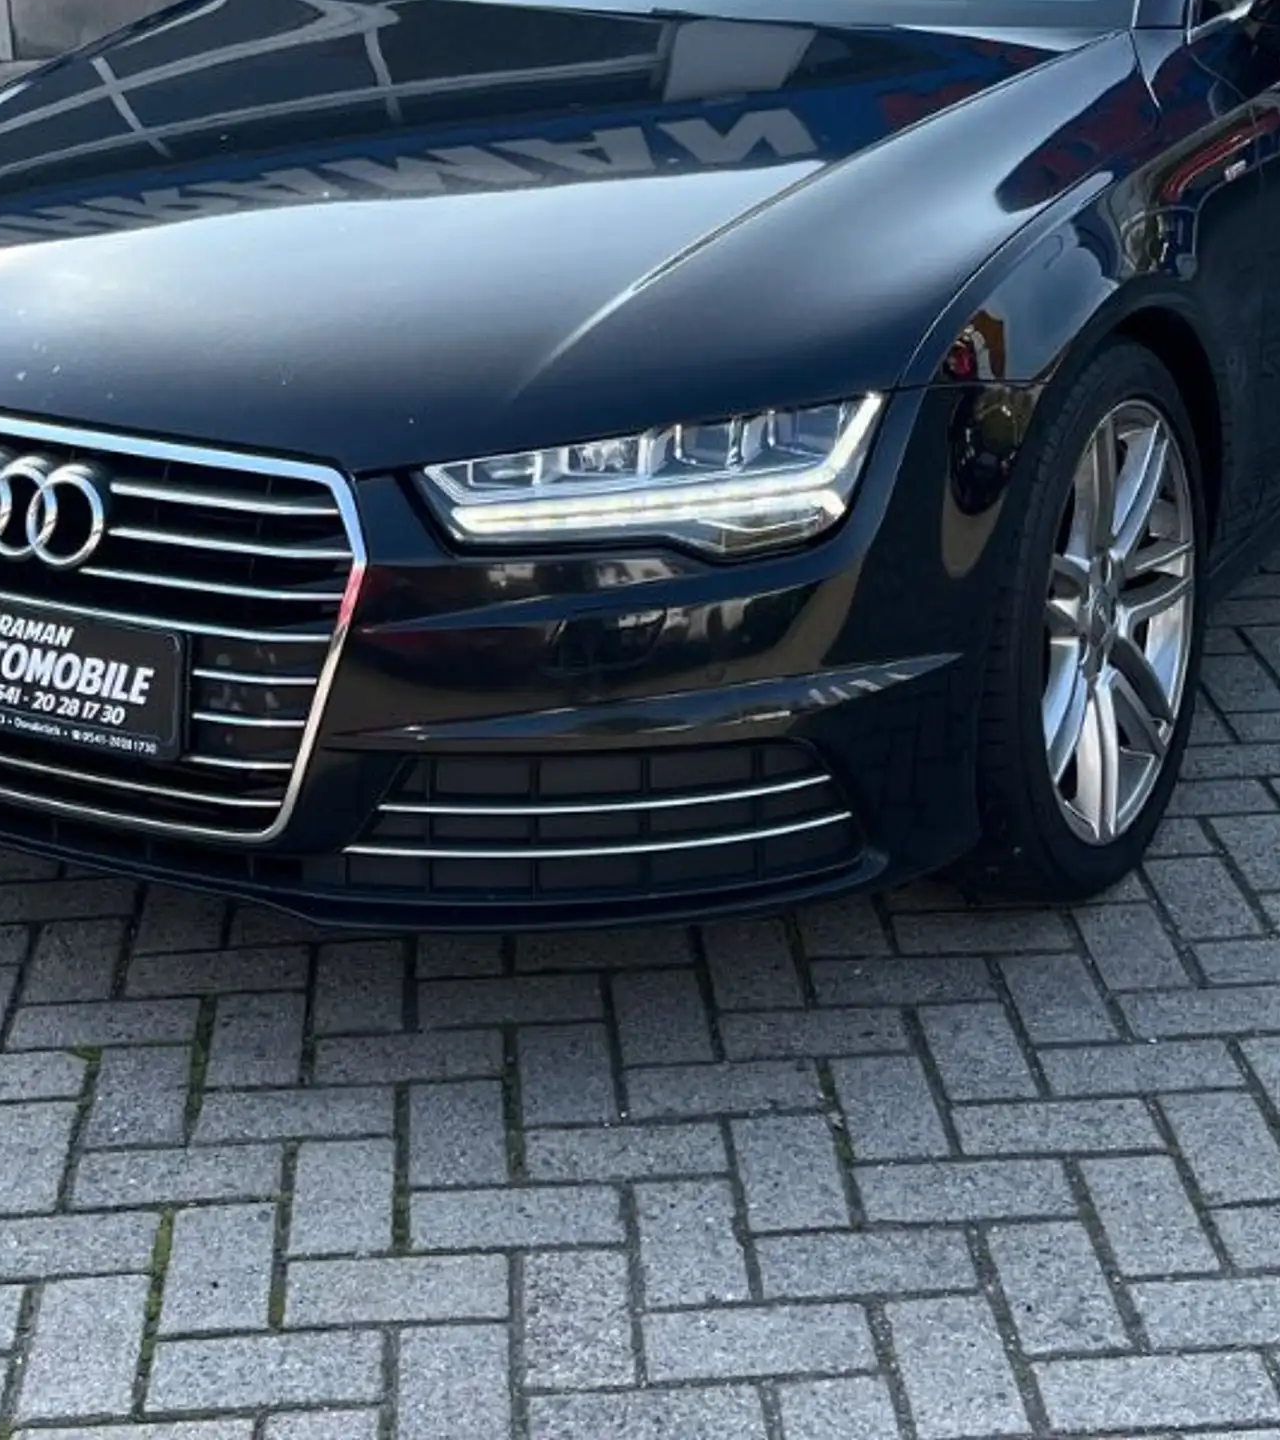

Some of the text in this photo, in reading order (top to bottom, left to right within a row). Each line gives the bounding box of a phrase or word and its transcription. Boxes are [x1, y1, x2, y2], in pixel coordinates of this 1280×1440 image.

[31, 691, 56, 712] 20
[57, 696, 80, 717] 28
[81, 700, 102, 720] 17
[100, 705, 126, 726] 30
